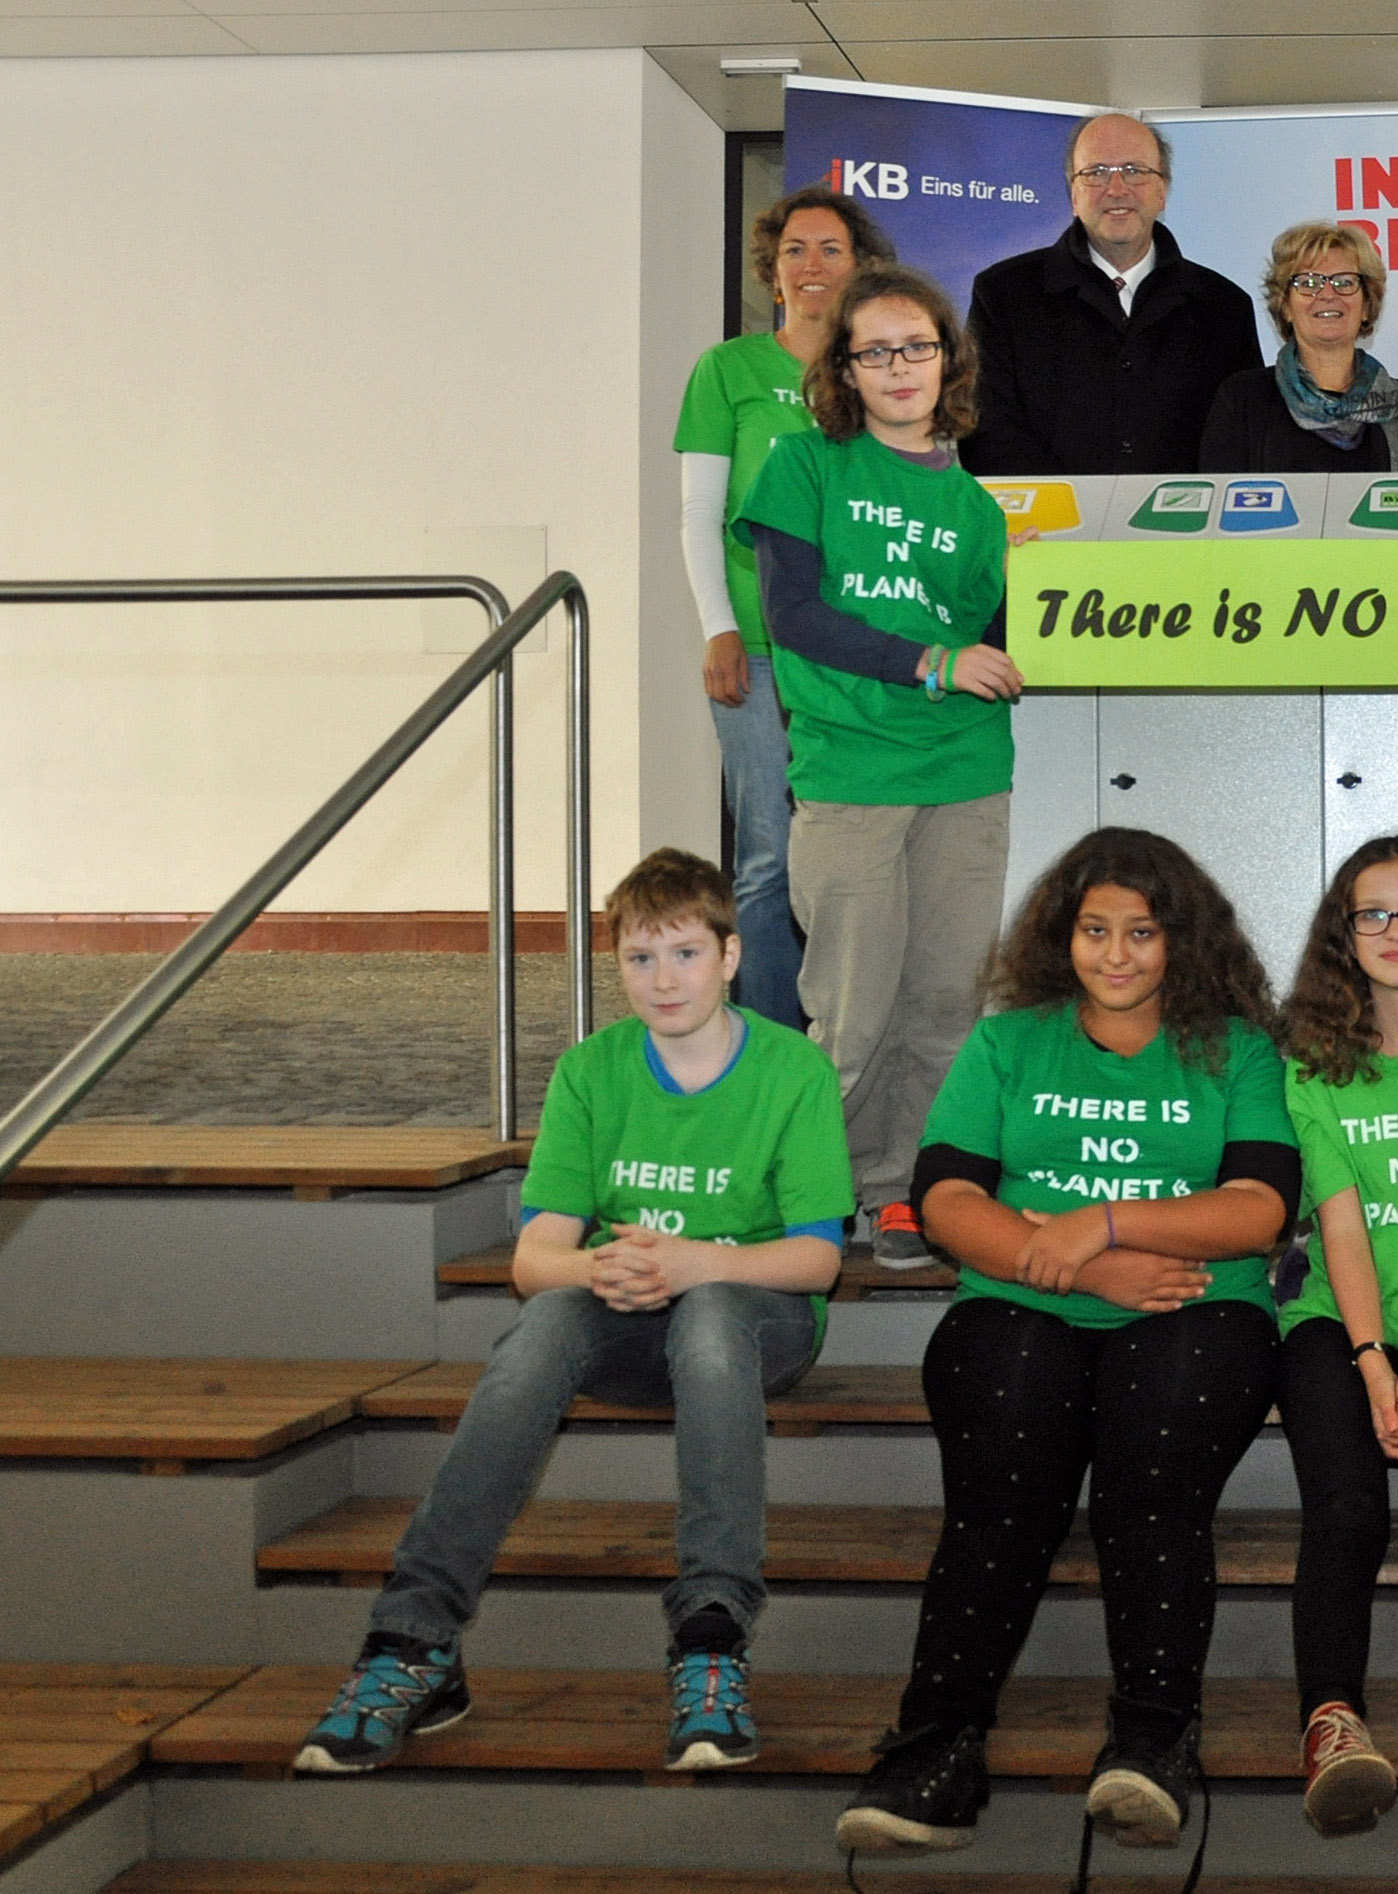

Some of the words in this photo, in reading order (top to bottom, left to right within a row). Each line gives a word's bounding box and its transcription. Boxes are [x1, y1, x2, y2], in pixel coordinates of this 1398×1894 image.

[920, 175, 963, 197] Eins
[968, 180, 995, 200] für
[1000, 184, 1040, 204] alle.
[931, 526, 958, 553] IS
[1037, 589, 1192, 639] There
[1213, 588, 1262, 644] is
[1284, 587, 1387, 638] NO
[1032, 1093, 1147, 1122] THERE
[1161, 1099, 1191, 1124] IS
[1081, 1136, 1140, 1163] NO
[706, 1168, 732, 1195] IS
[638, 1207, 685, 1236] NO
